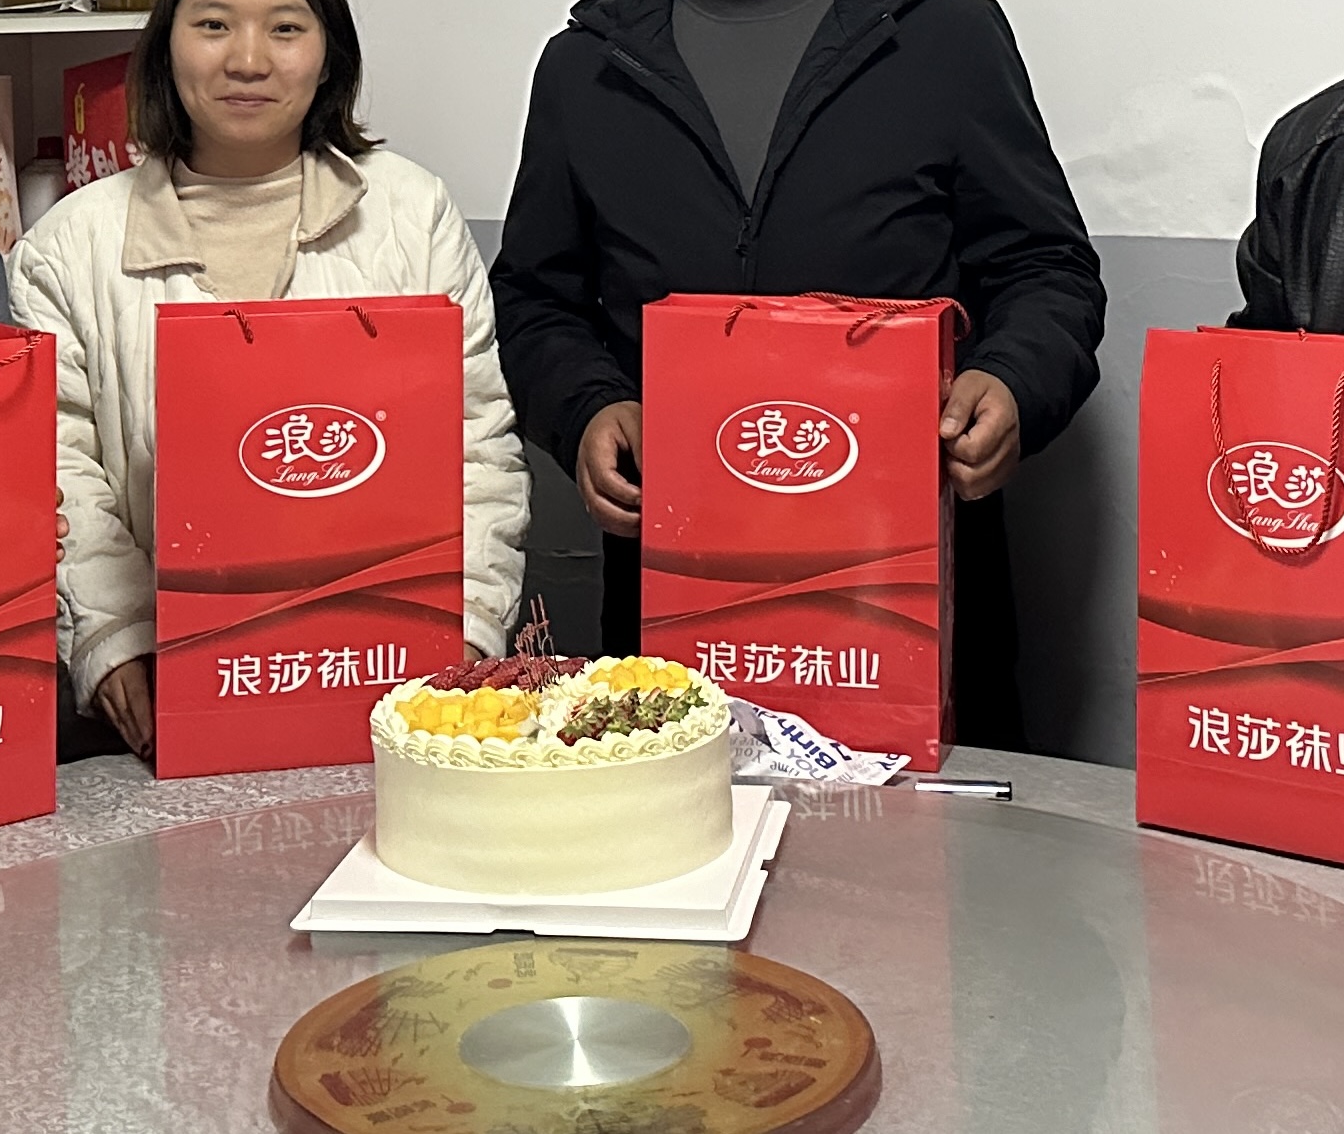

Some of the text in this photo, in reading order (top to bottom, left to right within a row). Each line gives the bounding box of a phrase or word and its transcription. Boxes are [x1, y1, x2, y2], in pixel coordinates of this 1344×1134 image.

[260, 413, 358, 464] 浪莎
[736, 408, 831, 460] 浪莎
[1227, 450, 1326, 510] 浪莎
[217, 642, 407, 698] 浪莎袜业
[695, 640, 880, 690] 浪莎袜业
